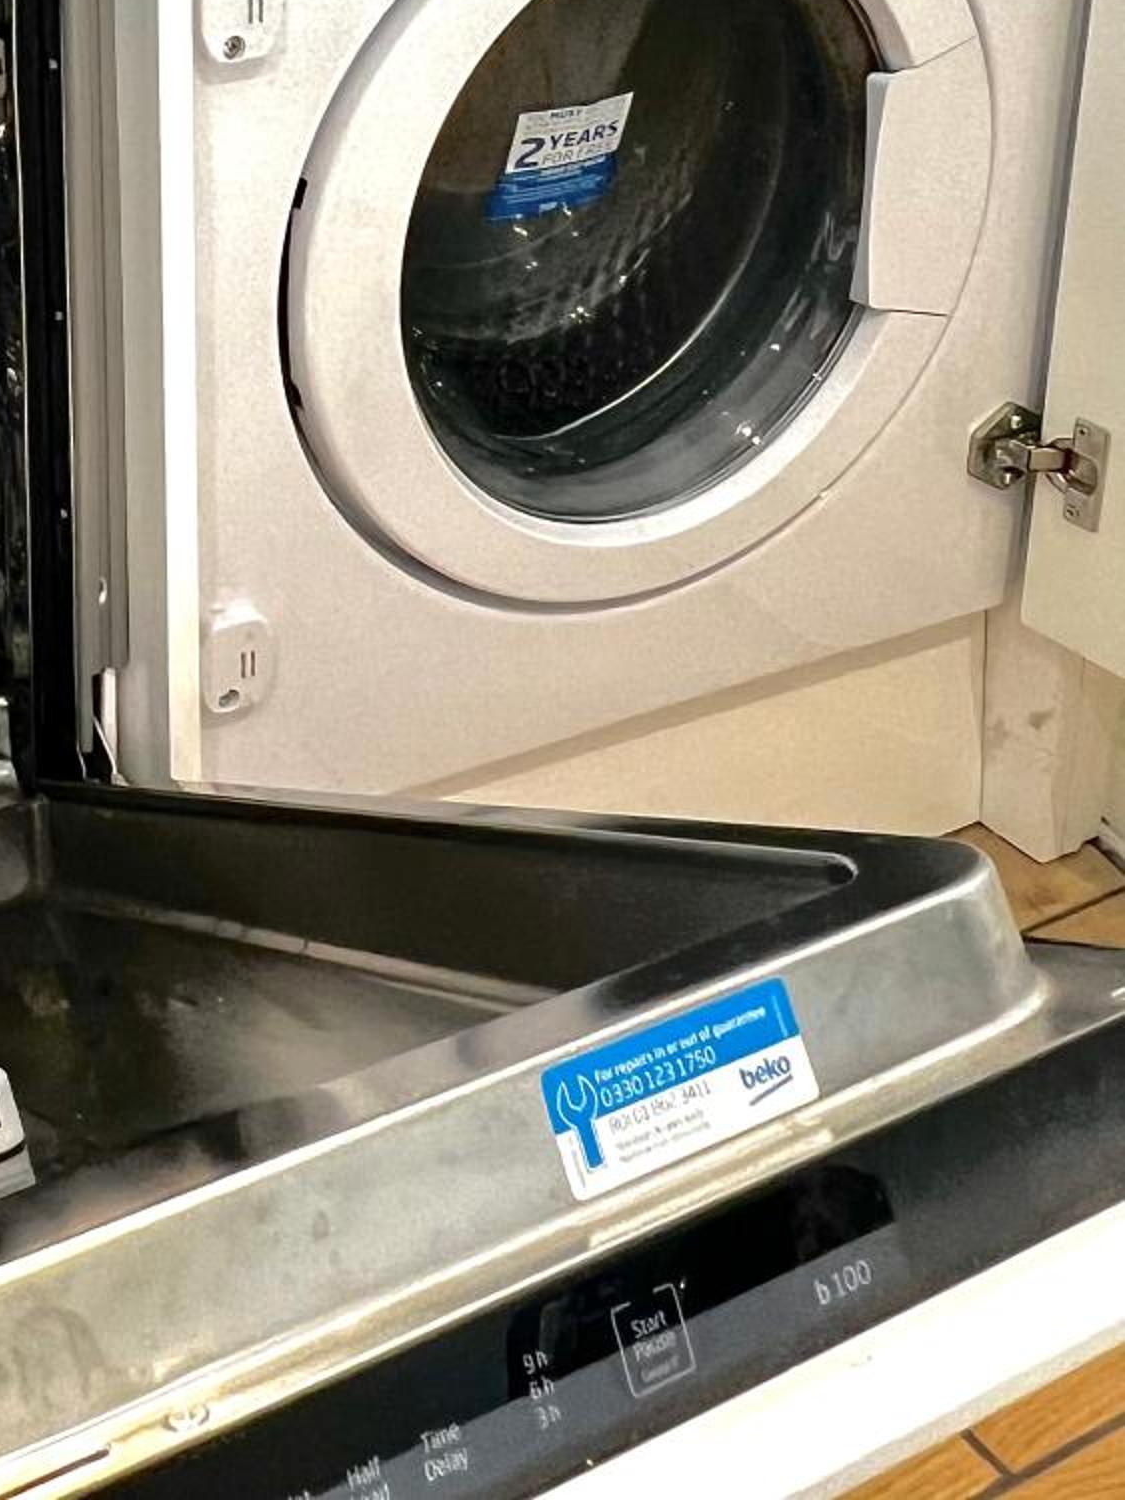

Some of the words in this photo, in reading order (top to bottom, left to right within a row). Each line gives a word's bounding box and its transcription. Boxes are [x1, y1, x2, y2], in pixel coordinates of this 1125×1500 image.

[514, 137, 546, 169] 2
[550, 119, 620, 150] YEARS
[594, 1068, 613, 1085] For
[713, 1006, 767, 1040] guarantee
[600, 1075, 644, 1107] 0330
[644, 1061, 676, 1090] 123
[676, 1045, 717, 1077] 1750
[739, 1055, 792, 1091] beko
[630, 1309, 667, 1339] Start
[421, 1422, 461, 1452] Time
[346, 1455, 381, 1490] Half
[425, 1448, 469, 1482] Delay
